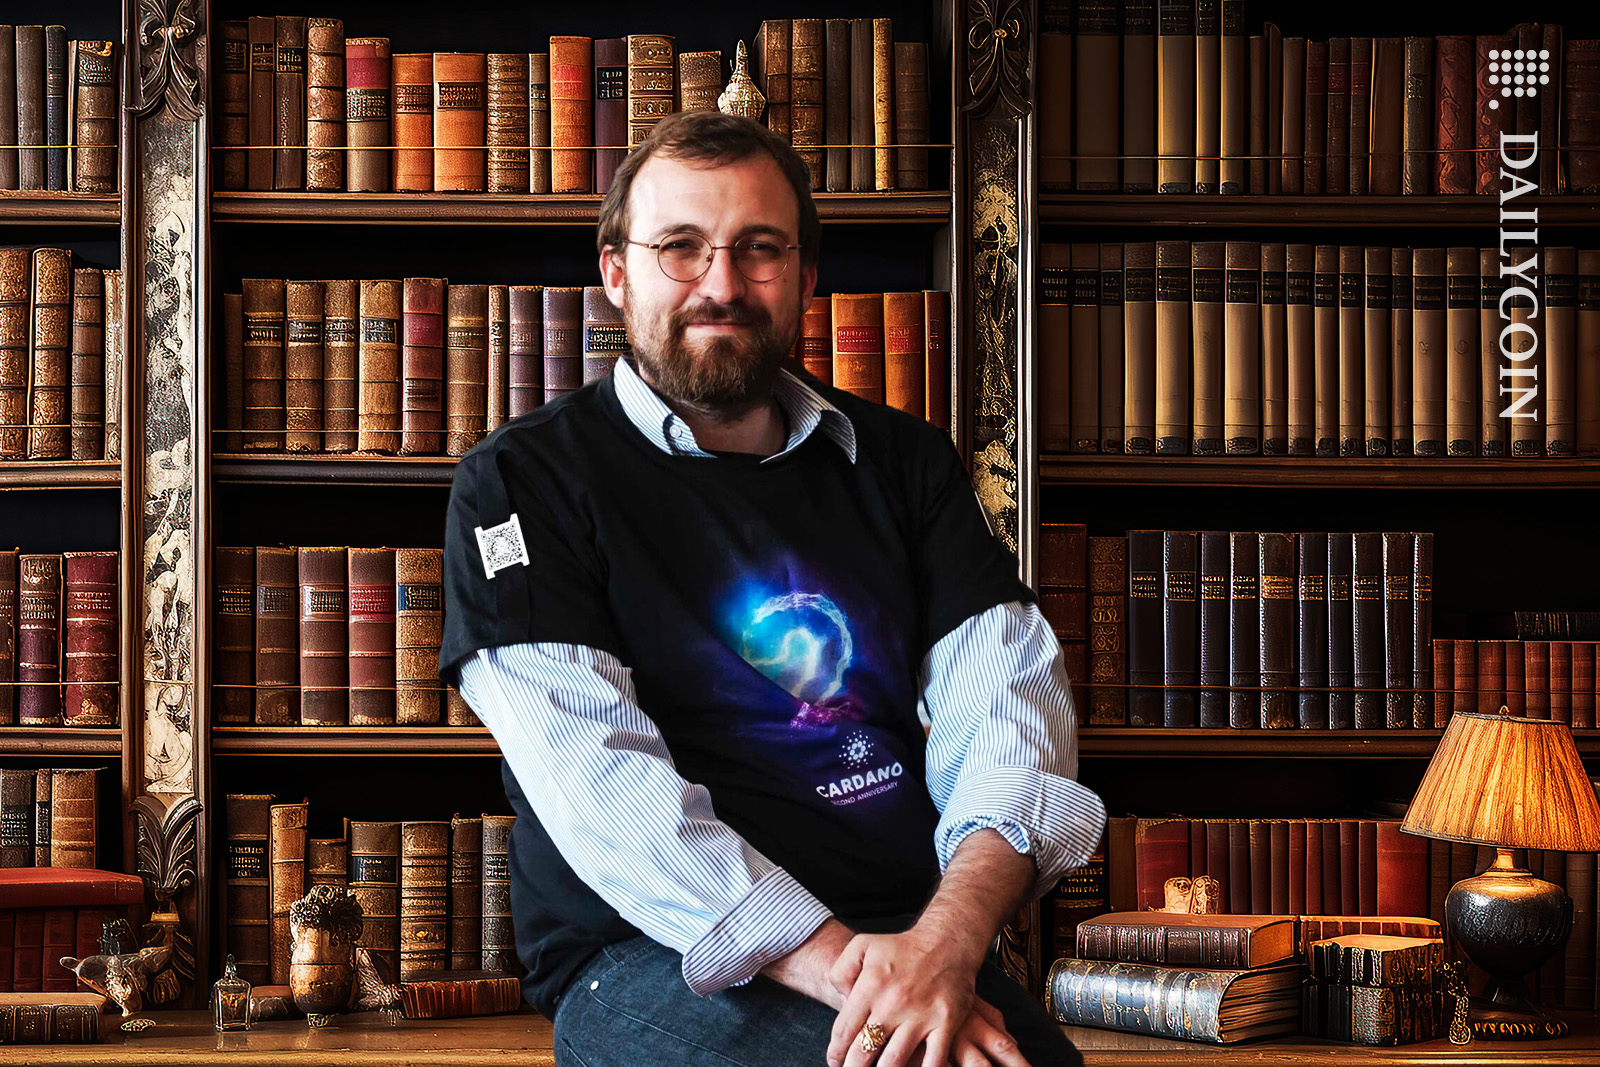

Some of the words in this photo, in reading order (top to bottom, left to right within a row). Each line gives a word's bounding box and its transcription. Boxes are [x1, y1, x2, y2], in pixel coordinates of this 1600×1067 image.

[816, 762, 903, 798] CARDANO
[831, 796, 856, 806] ECOND
[857, 781, 898, 801] ANNIVERSARY
